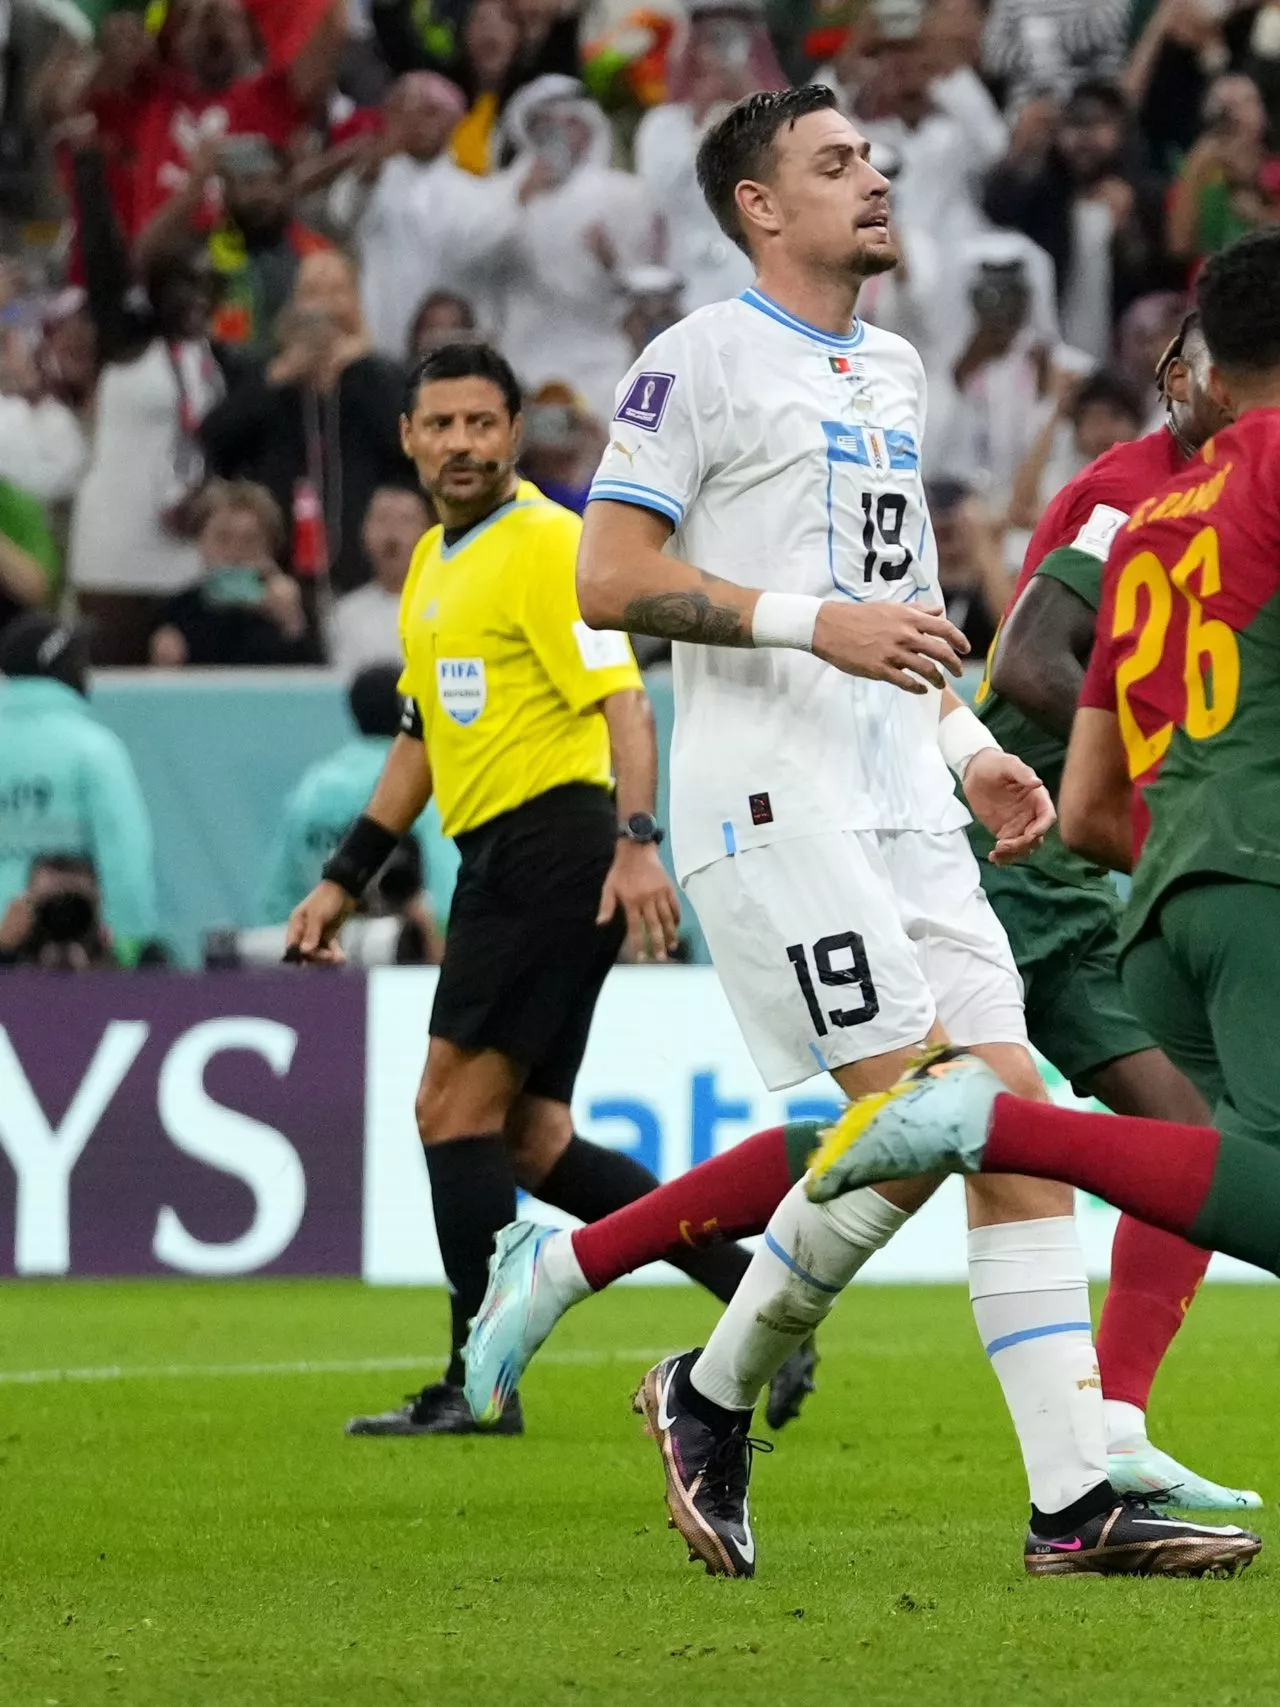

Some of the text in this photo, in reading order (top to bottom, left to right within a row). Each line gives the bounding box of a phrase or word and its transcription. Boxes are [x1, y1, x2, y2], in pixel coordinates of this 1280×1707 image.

[861, 492, 914, 583] 19
[441, 662, 479, 678] FIFA
[1112, 525, 1240, 781] 26
[786, 930, 880, 1038] 19
